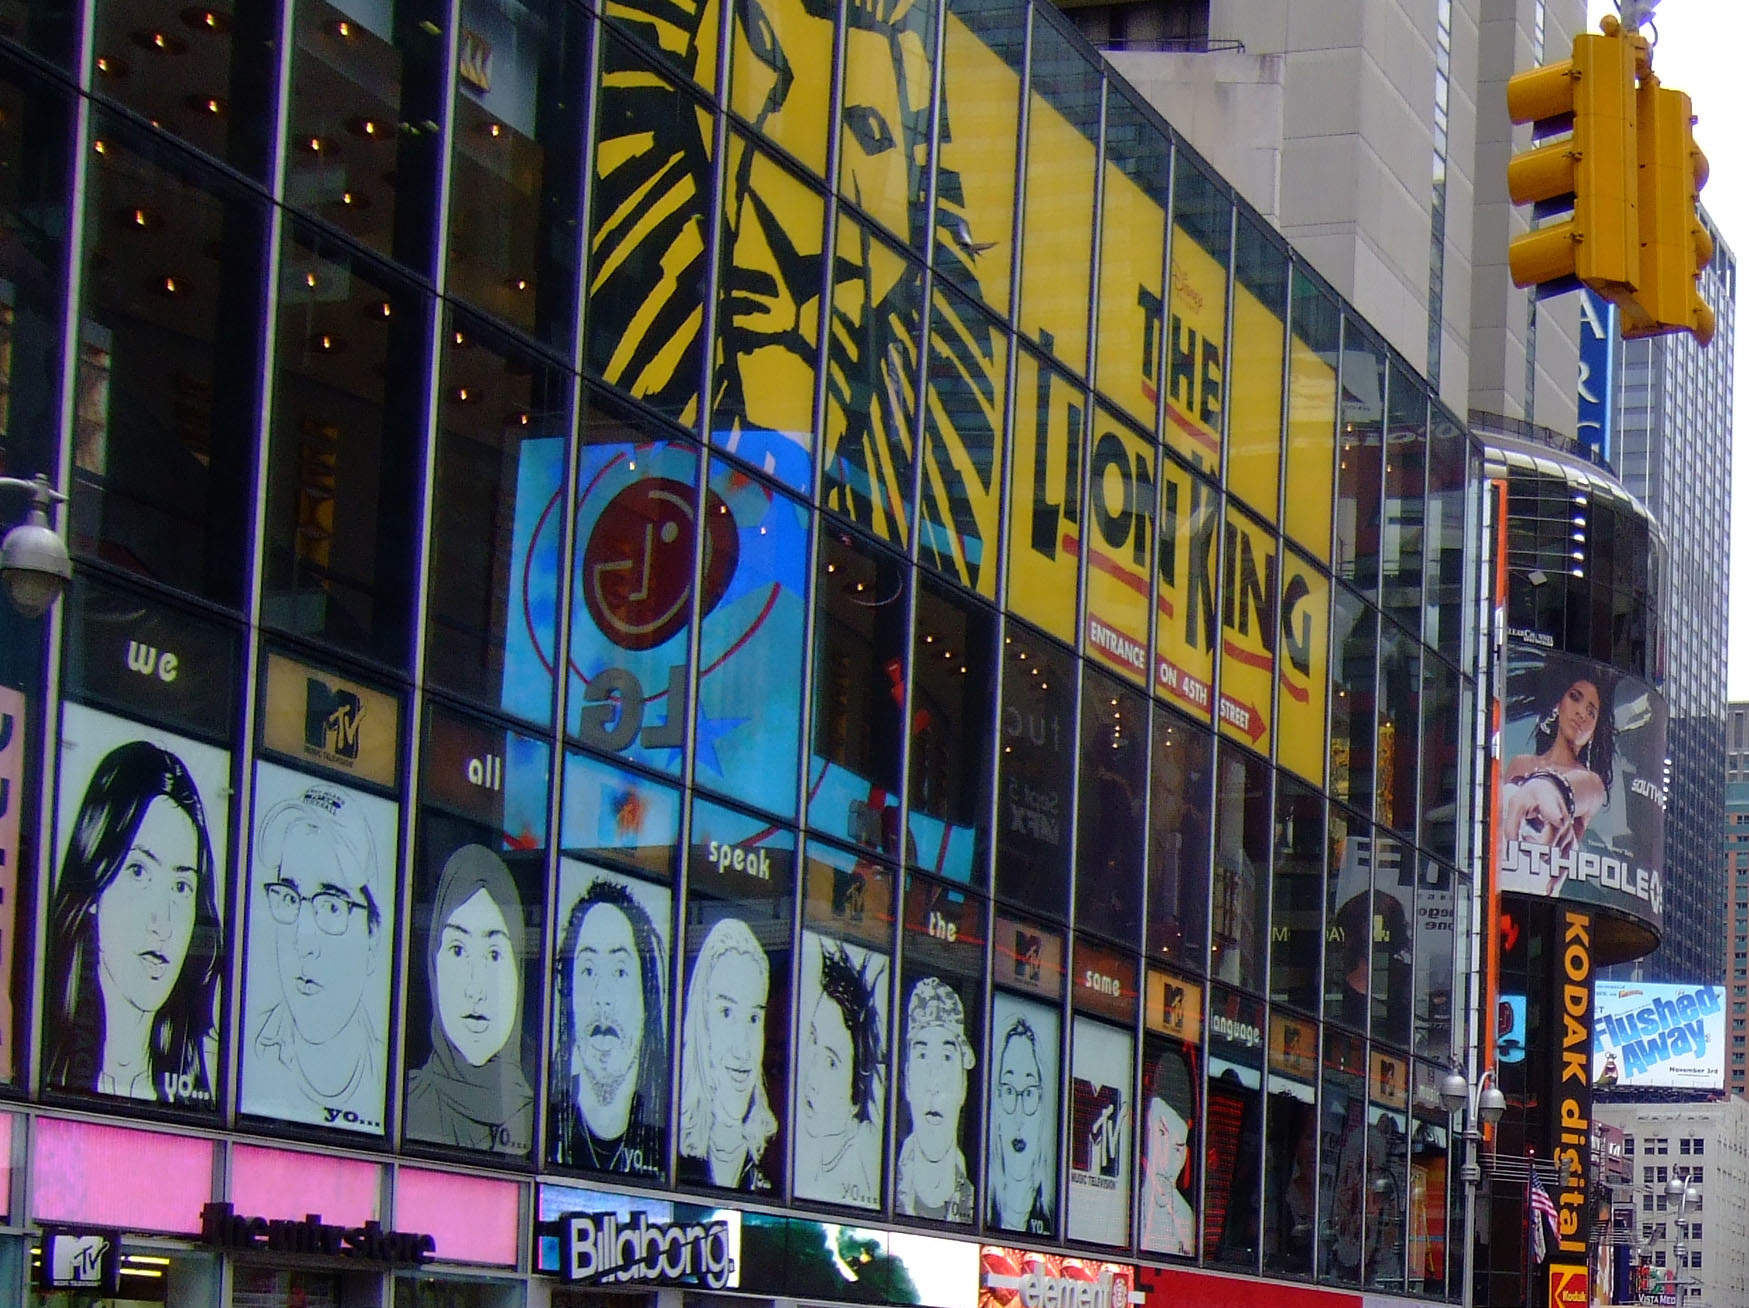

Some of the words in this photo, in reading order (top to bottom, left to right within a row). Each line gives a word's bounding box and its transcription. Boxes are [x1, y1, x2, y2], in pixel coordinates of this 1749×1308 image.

[1137, 283, 1221, 432] THE
[1032, 328, 1178, 590] LION
[1185, 450, 1311, 680] KING
[127, 639, 179, 682] we
[1090, 620, 1146, 670] ENTRANCE
[1160, 661, 1178, 688] ON
[1183, 677, 1208, 706] 45TH
[1219, 697, 1250, 731] STREET
[305, 677, 367, 760] MTV
[468, 753, 501, 791] all
[709, 838, 771, 880] speak
[928, 910, 957, 943] the
[1085, 969, 1121, 997] same
[1561, 910, 1590, 1088] KODAK
[1210, 1007, 1260, 1047] language
[1594, 984, 1721, 1054] Flushed
[1621, 1017, 1707, 1079] Away
[1072, 1076, 1127, 1177] MTV
[1553, 1098, 1588, 1253] digital
[52, 1235, 109, 1282] MTV
[1562, 1289, 1586, 1302] Kodak
[1638, 1293, 1660, 1305] VISTA
